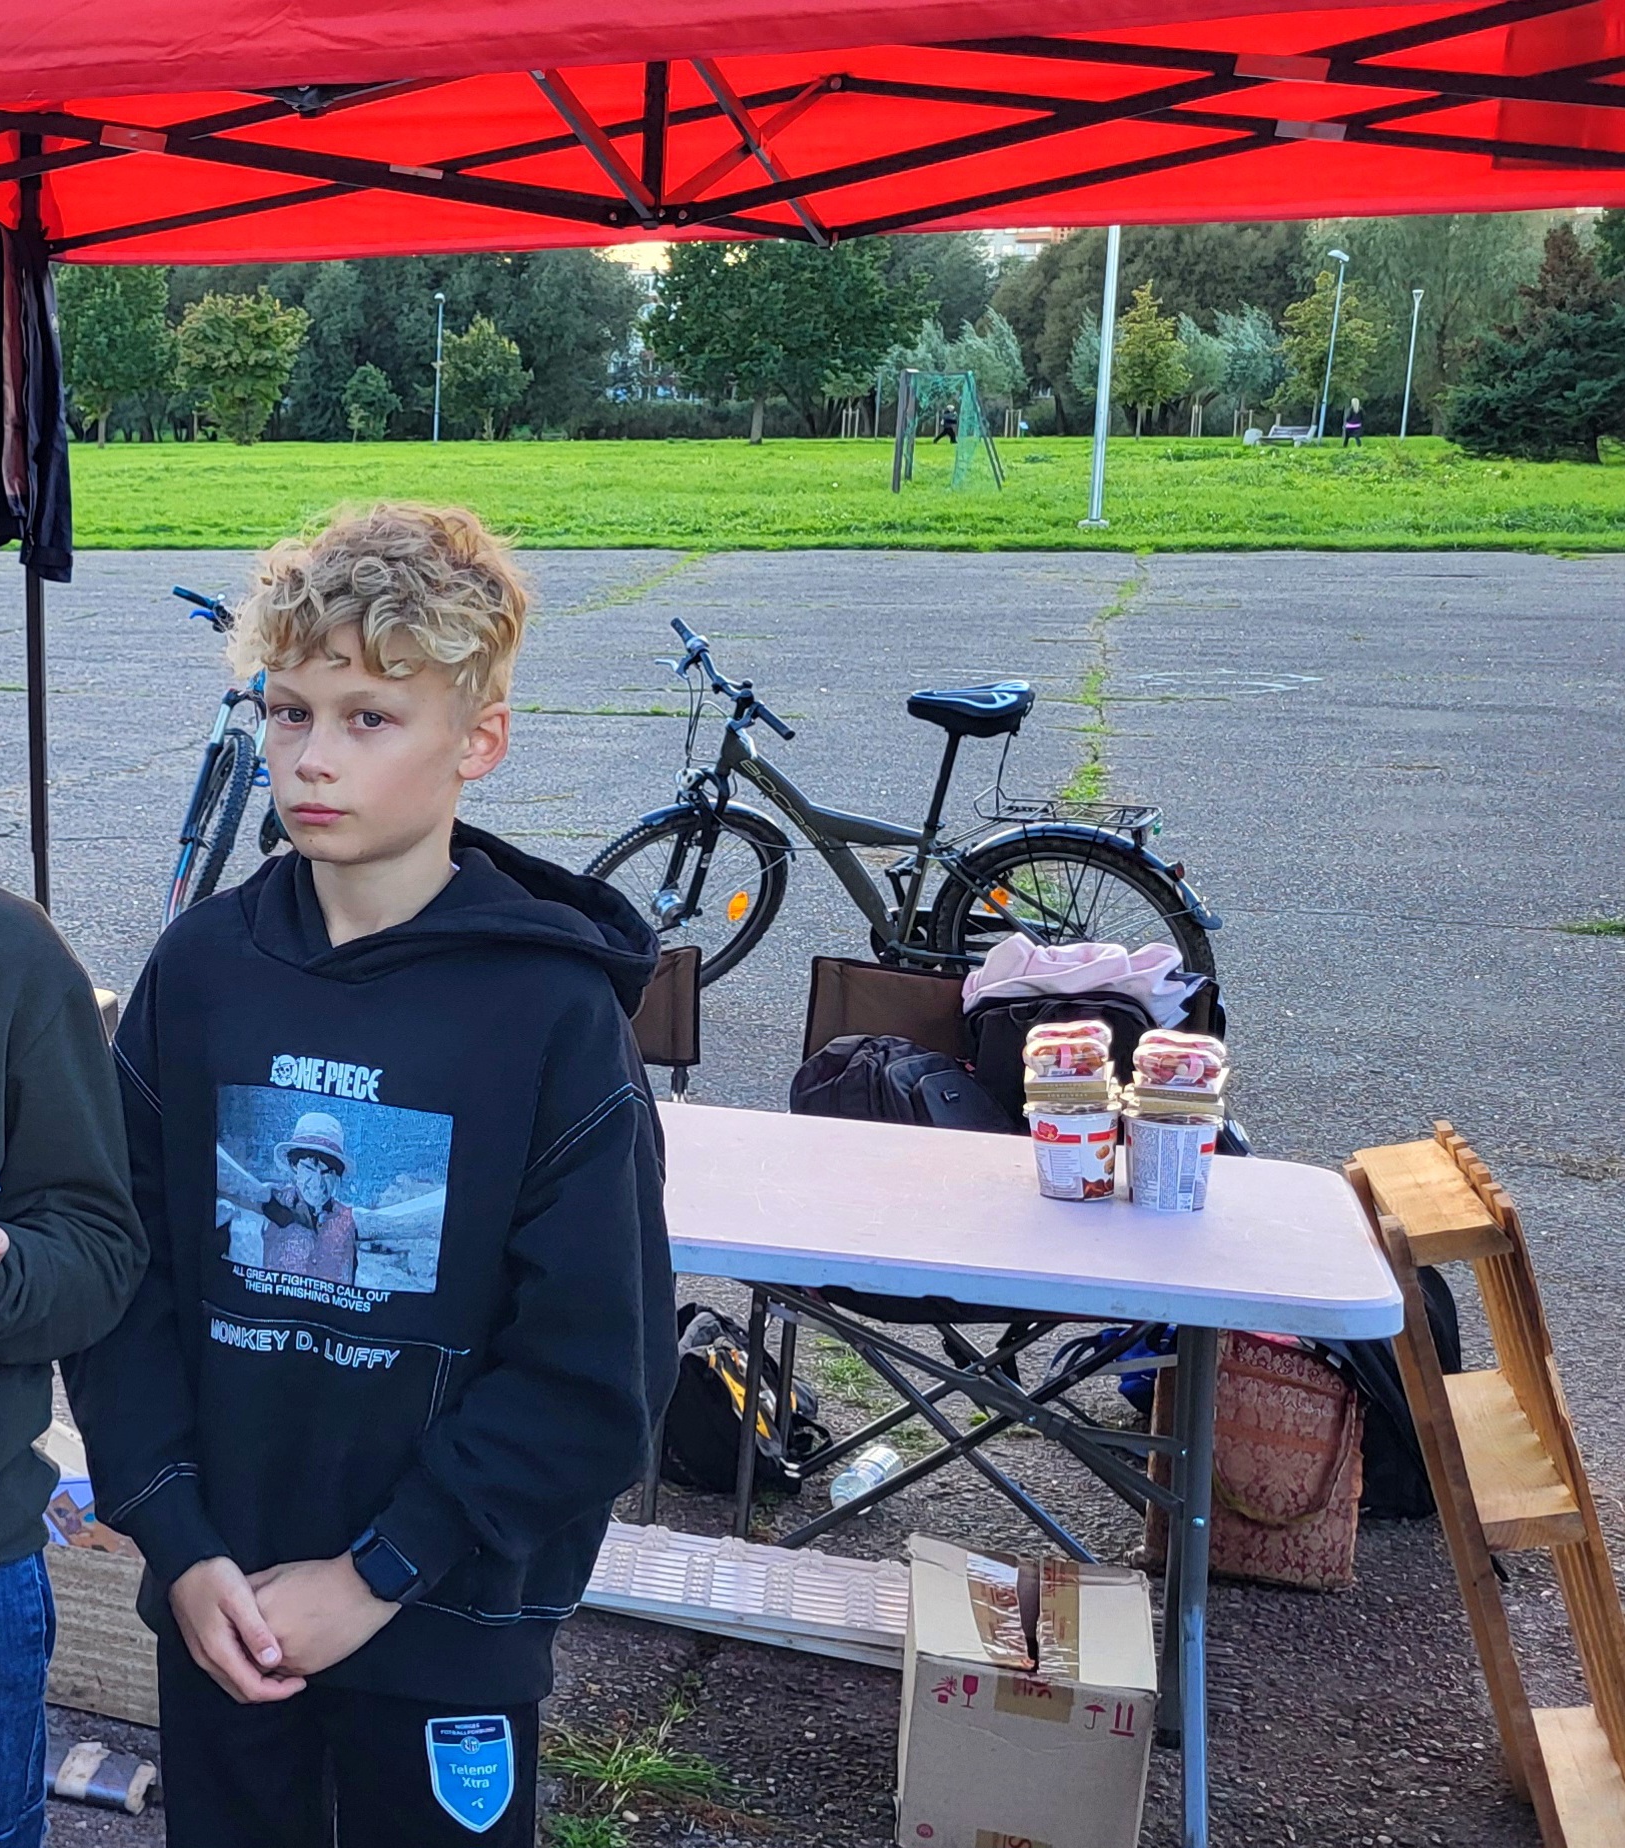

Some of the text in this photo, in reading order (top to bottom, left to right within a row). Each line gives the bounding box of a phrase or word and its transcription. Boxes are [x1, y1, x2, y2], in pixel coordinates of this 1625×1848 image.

[739, 759, 822, 842] BOCAS
[270, 1054, 383, 1102] ONE PIECE
[232, 1265, 391, 1303] ALL GREAT FIGHTERS CALL OUT
[244, 1278, 372, 1314] THEIR FINISHING MOVES
[210, 1317, 401, 1369] MONKEY D. LUFFY
[449, 1764, 498, 1775] Telenor
[462, 1777, 490, 1788] Xtra
